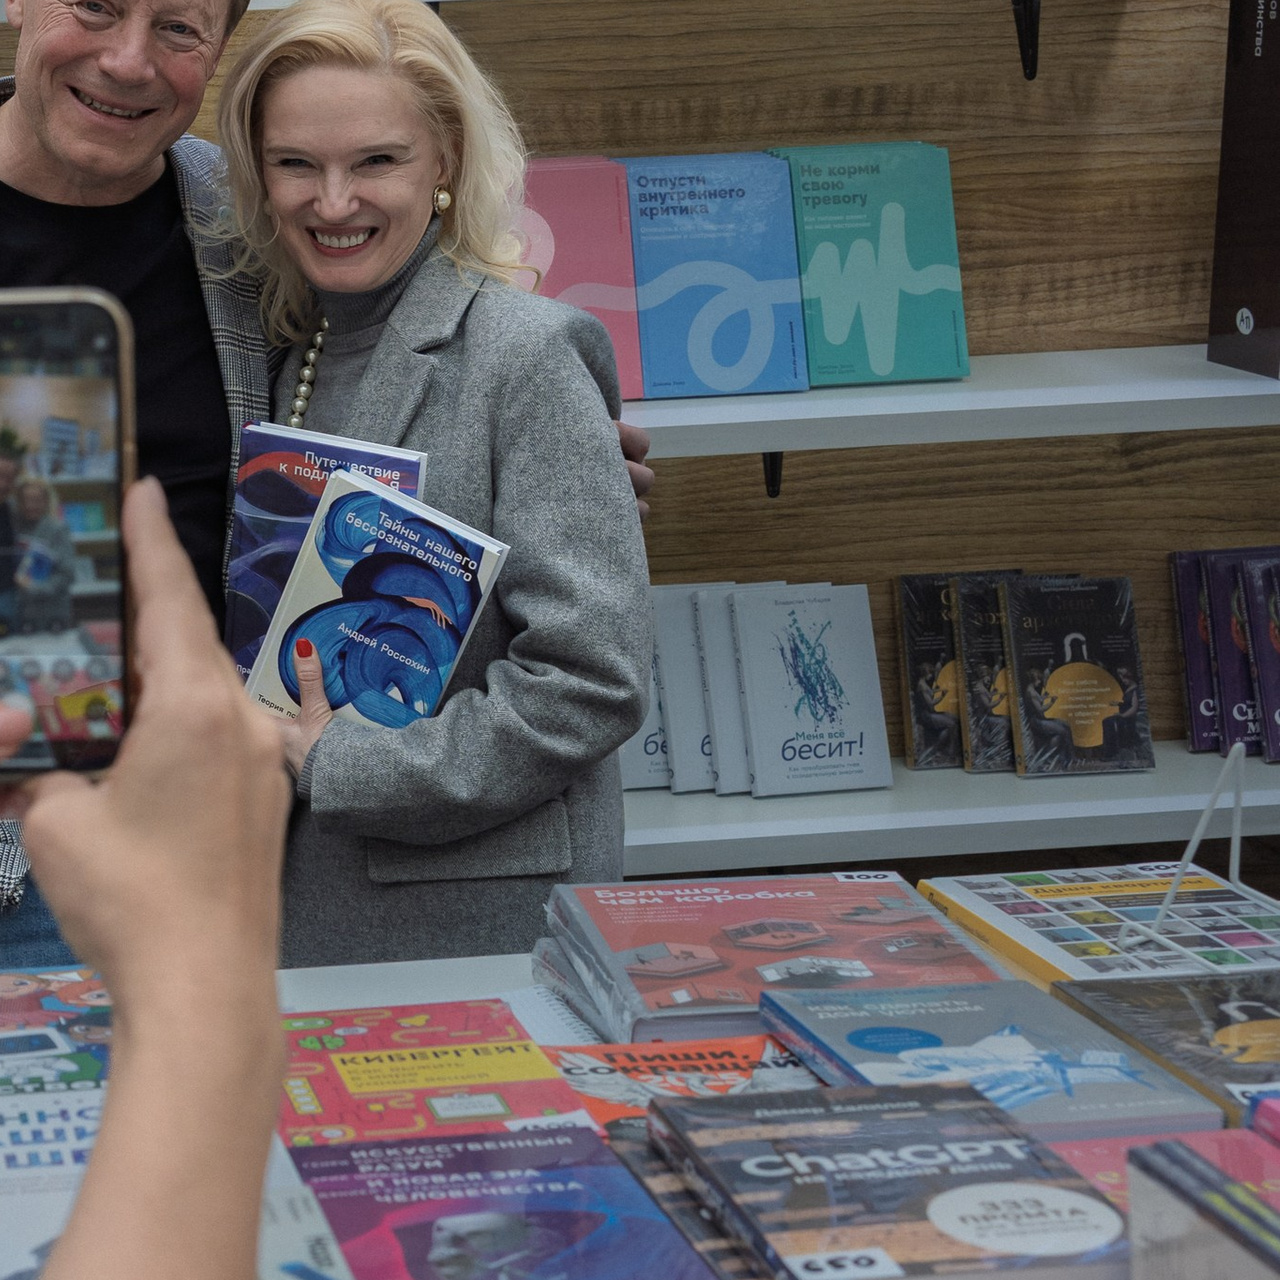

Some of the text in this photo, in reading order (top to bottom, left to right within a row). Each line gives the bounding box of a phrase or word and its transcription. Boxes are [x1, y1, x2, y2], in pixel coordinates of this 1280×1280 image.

[800, 164, 880, 179] Не корми
[637, 175, 706, 189] Отпусти
[802, 179, 844, 192] свою
[638, 188, 746, 203] внутреннего
[802, 194, 868, 208] тревогу
[640, 204, 709, 219] критика
[279, 463, 288, 473] к
[346, 512, 472, 582] бессознательного
[378, 512, 478, 570] Тайны нашего
[338, 622, 432, 675] Андрей Россохин
[258, 693, 286, 714] Теория
[796, 729, 845, 741] Меня всё
[782, 732, 864, 762] бесит!
[594, 886, 730, 898] Больше,
[598, 889, 816, 906] чем коробка
[1032, 884, 1094, 896] Душа
[928, 892, 948, 917] Душа
[563, 1051, 804, 1076] сокращай
[604, 1050, 750, 1064] Пиши,
[350, 1136, 574, 1158] ИСКУССТВЕННЫЙ
[358, 1160, 444, 1172] РАЗУМ
[741, 1140, 1028, 1178] ChatGPT
[366, 1168, 542, 1188] И НОВАЯ ЭРА
[794, 1162, 1013, 1186] на каждый день
[374, 1181, 584, 1203] ЧЕЛОВЕЧЕСТВА
[979, 1198, 1044, 1211] 333
[959, 1206, 1088, 1225] ПРОМТА
